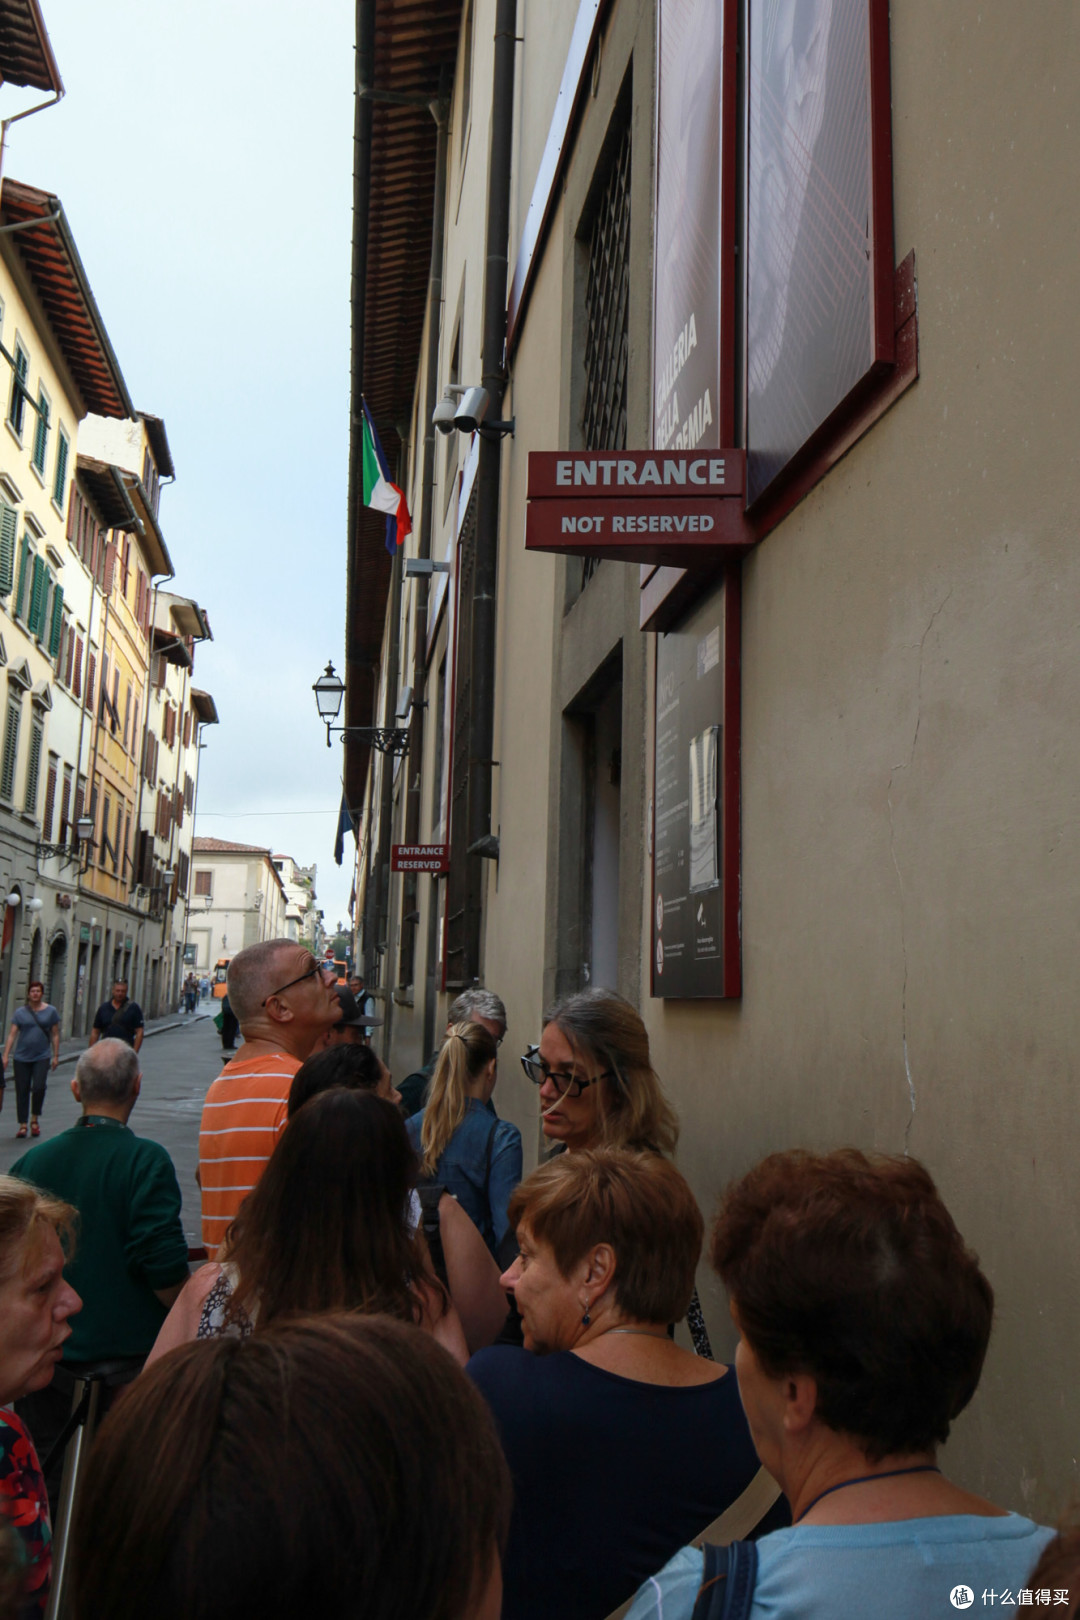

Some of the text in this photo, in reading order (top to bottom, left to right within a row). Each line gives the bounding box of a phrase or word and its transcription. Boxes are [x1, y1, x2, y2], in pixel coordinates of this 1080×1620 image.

[656, 312, 698, 419] GALLERIA
[556, 459, 726, 486] ENTRANCE
[561, 515, 714, 533] NOT RESERVED
[398, 847, 444, 855] ENTRANCE
[397, 861, 442, 869] RESERVED
